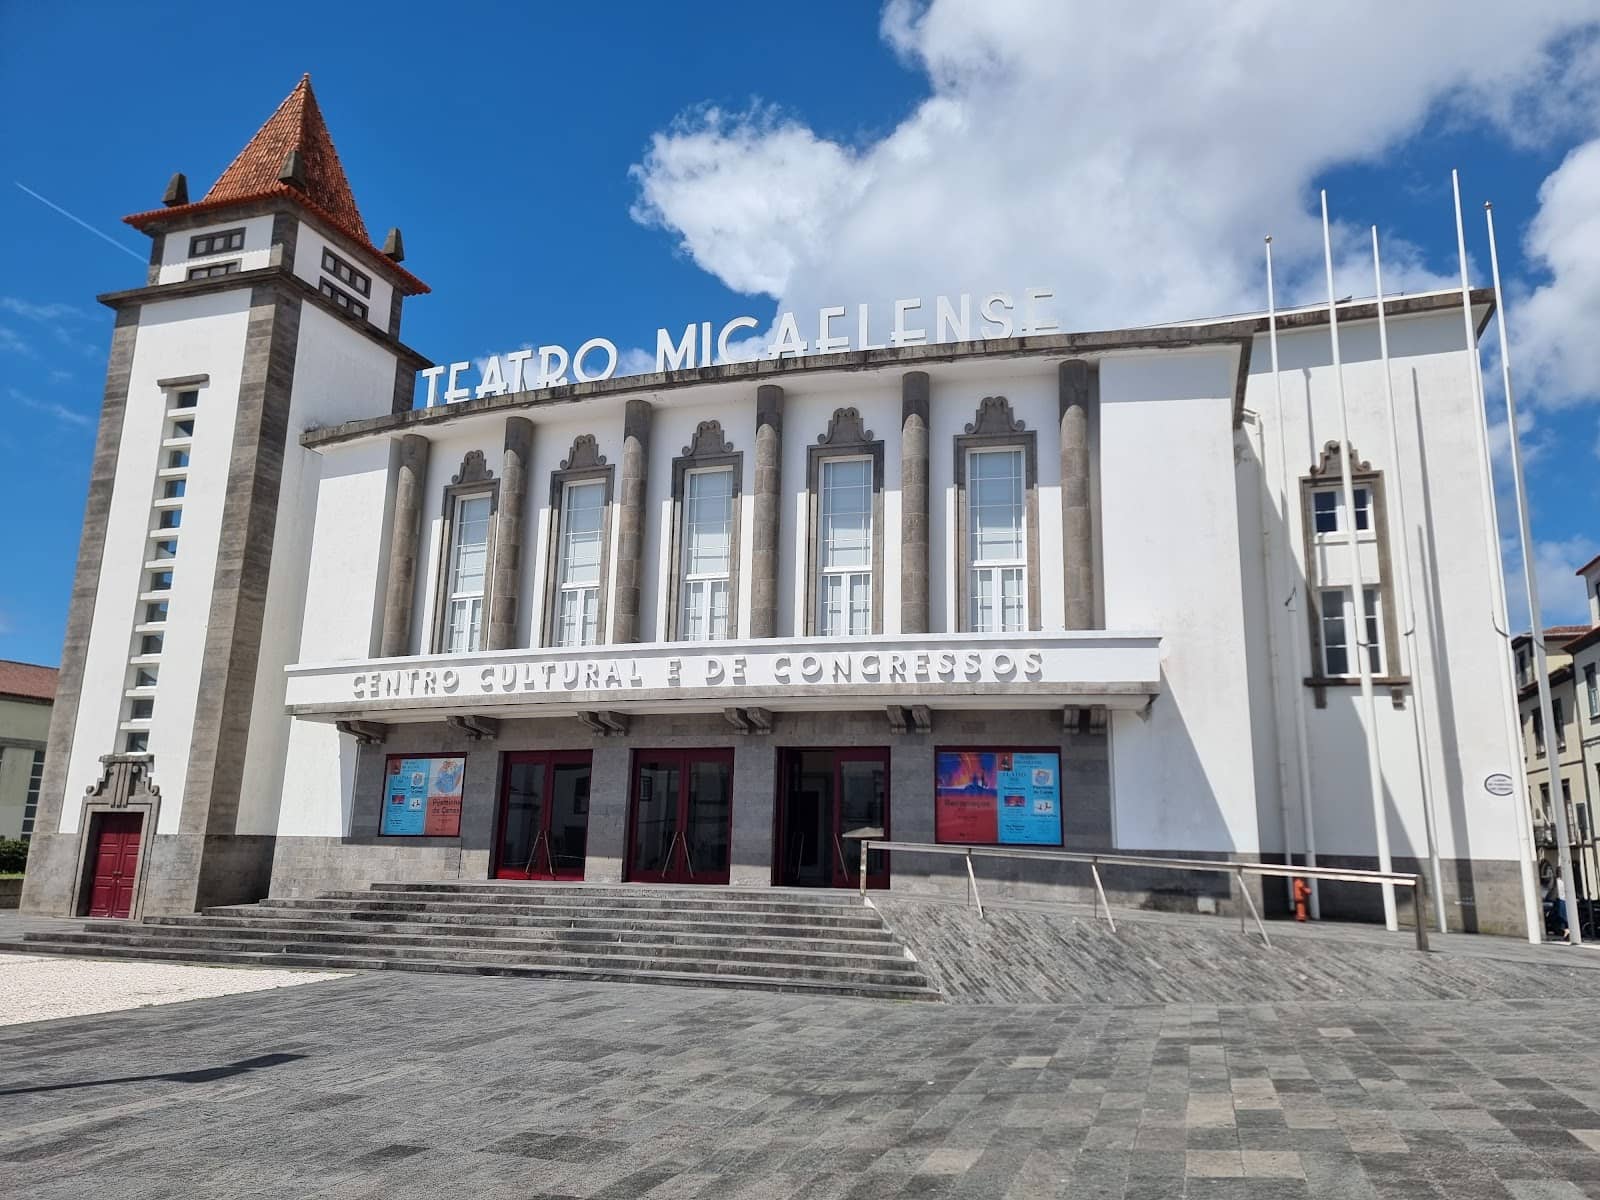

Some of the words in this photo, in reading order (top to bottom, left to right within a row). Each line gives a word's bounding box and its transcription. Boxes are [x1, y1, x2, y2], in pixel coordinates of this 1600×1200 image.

[421, 337, 619, 408] TEATRO
[655, 288, 1059, 373] MICAELENSE
[353, 669, 460, 699] CENTRO
[480, 659, 643, 693] CULTURAL
[667, 658, 682, 688] E
[705, 656, 747, 686] DE
[773, 650, 1043, 684] CONGRESSOS
